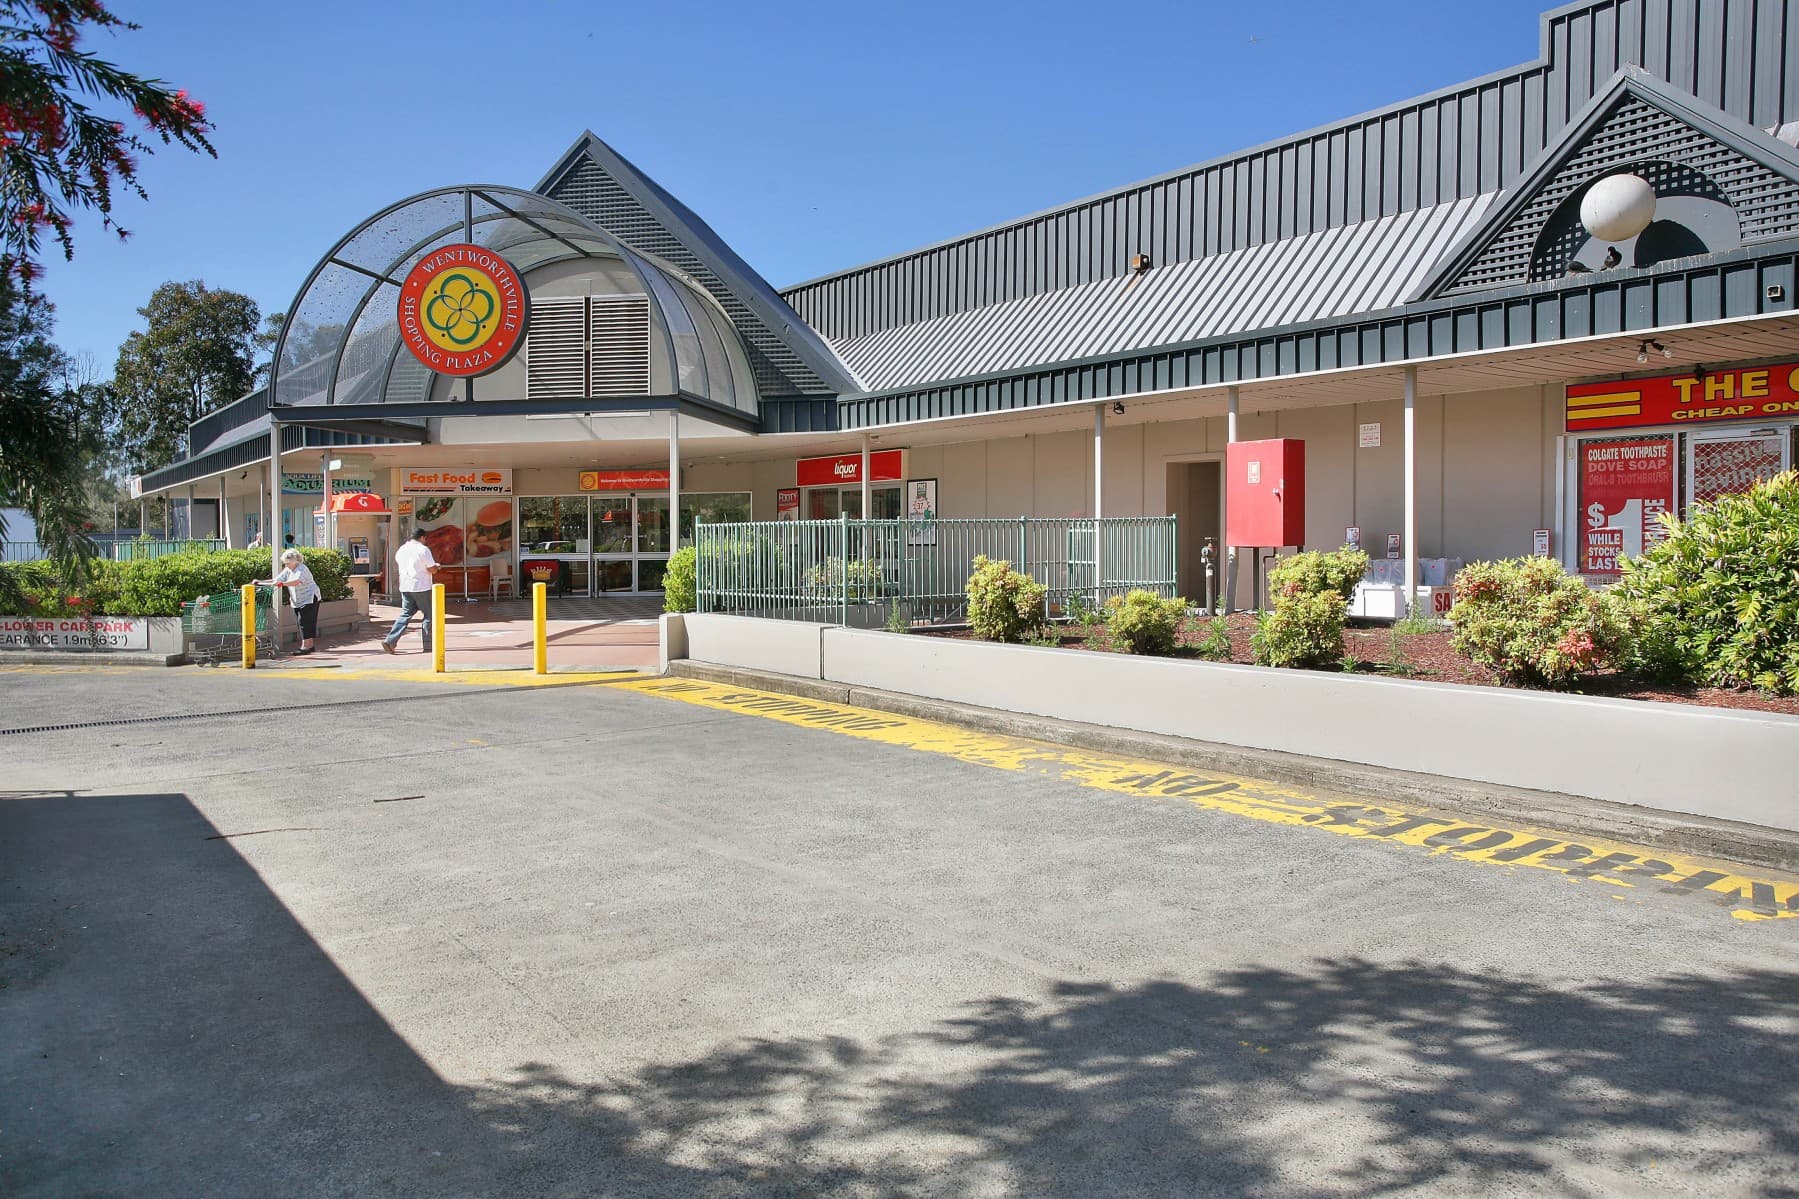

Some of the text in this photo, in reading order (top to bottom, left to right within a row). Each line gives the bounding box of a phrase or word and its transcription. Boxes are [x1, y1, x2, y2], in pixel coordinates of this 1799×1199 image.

[422, 250, 518, 331] WENTWORTHVILLE
[404, 296, 493, 369] SHOPPING PLAZA
[1672, 370, 1769, 403] THE
[1671, 405, 1754, 420] CHEAP
[1588, 444, 1667, 461] COLGATE TOOTHPASTE
[834, 460, 857, 479] liquor
[1588, 459, 1667, 473] DOVE SOAP
[409, 472, 476, 483] Fast Food
[460, 485, 504, 493] Takeaway
[1588, 533, 1620, 545] WHILE
[1588, 546, 1621, 557] STOCKS
[1588, 557, 1619, 570] LAST
[60, 621, 88, 631] CAR
[95, 622, 133, 632] PARK
[703, 693, 907, 731] STOPPING
